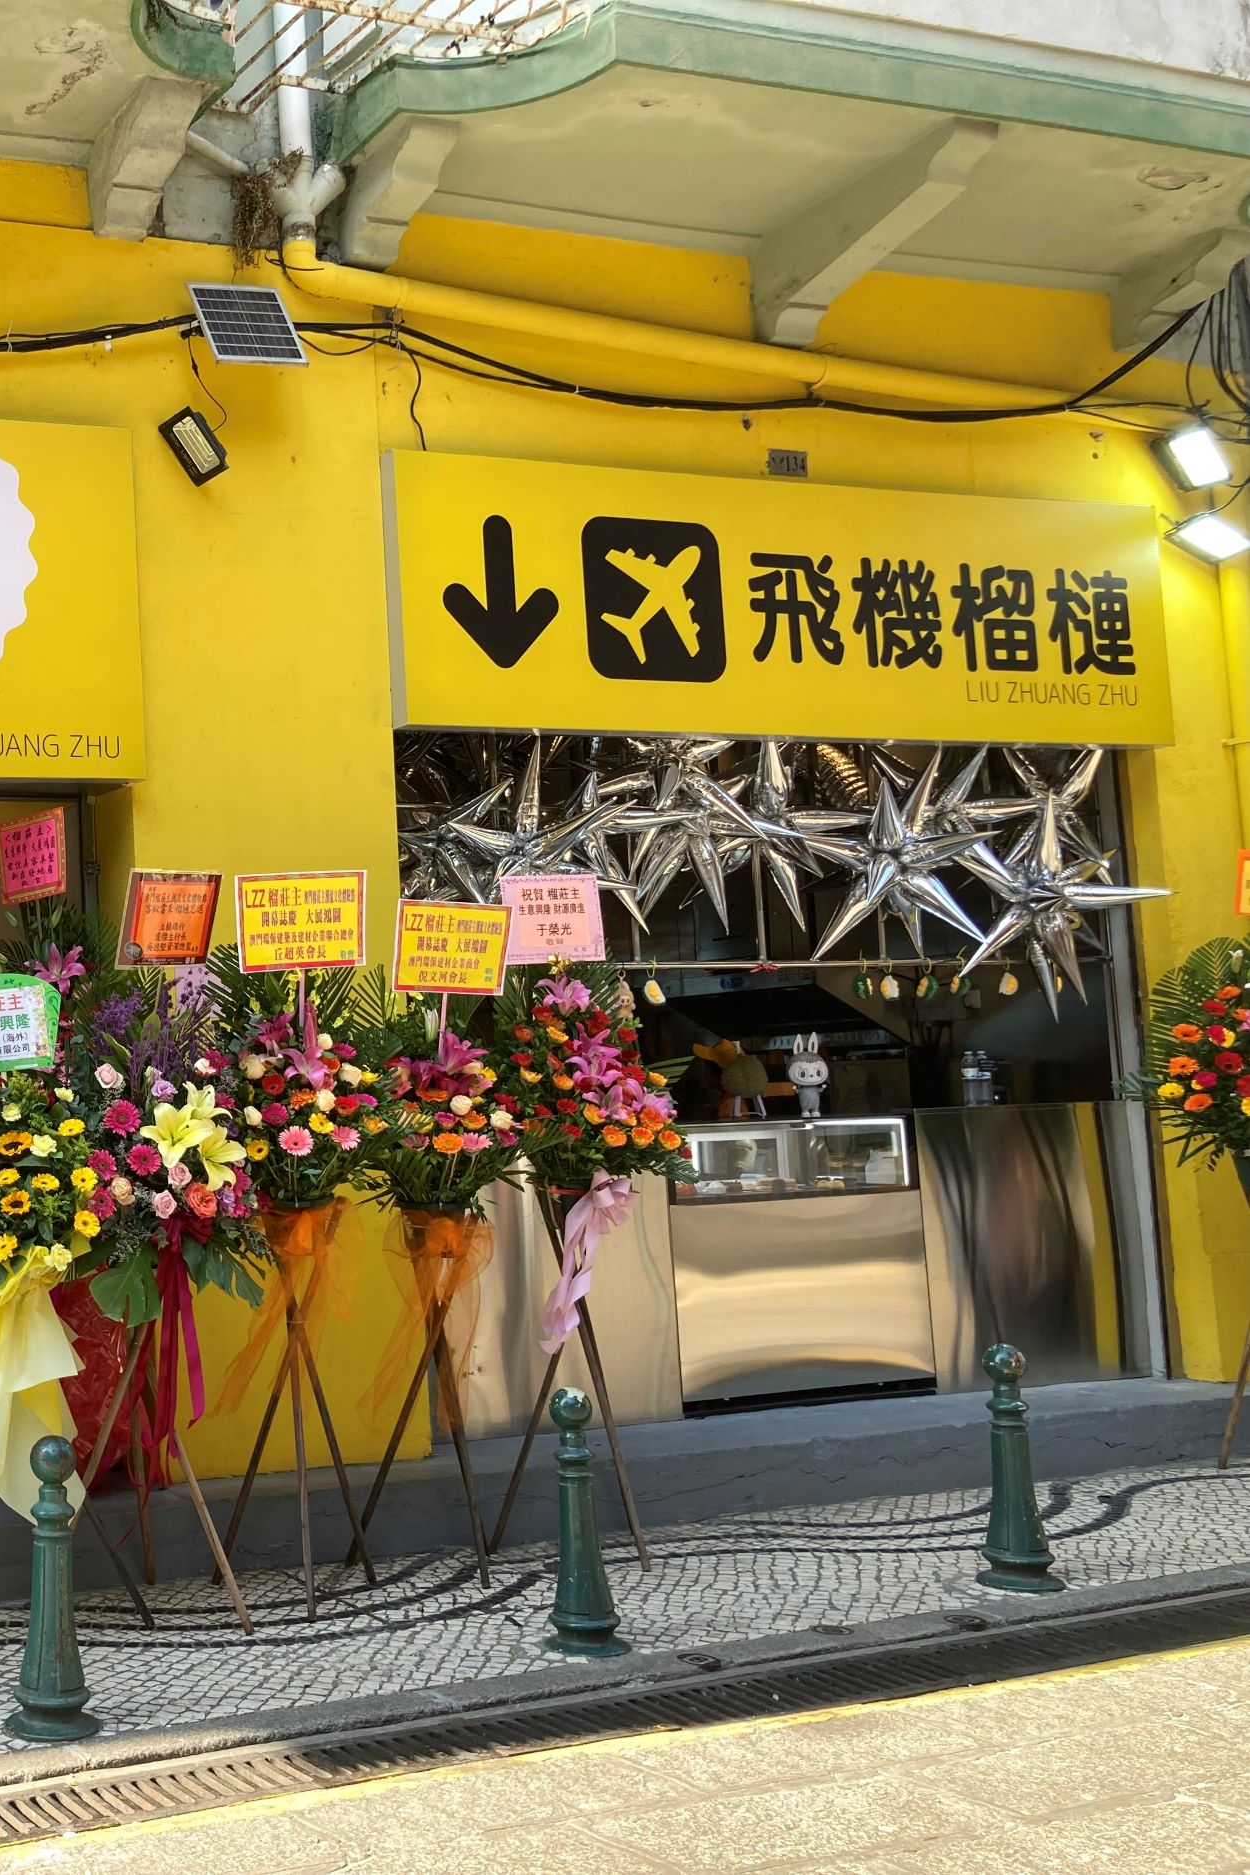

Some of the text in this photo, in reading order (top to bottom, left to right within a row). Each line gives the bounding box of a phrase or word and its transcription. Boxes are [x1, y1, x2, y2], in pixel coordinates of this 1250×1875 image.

[748, 552, 1137, 676] 飛機榴槤
[965, 680, 1139, 707] LIU ZHUANG ZHU
[69, 734, 121, 759] ZHU
[245, 889, 266, 909] LZZ
[268, 887, 302, 909] 榴莊主
[521, 887, 581, 902] 祝賀 榴莊主
[262, 907, 342, 928] 開幕誌慶 大展鴻圖
[519, 903, 586, 916] 生意興隆 財源廣進
[404, 913, 424, 932] LZZ
[425, 913, 456, 934] 榴莊主
[536, 922, 572, 937] 于榮光
[417, 935, 489, 954] 開幕誌慶 大展鴻圖
[418, 970, 468, 984] 倪文河會長
